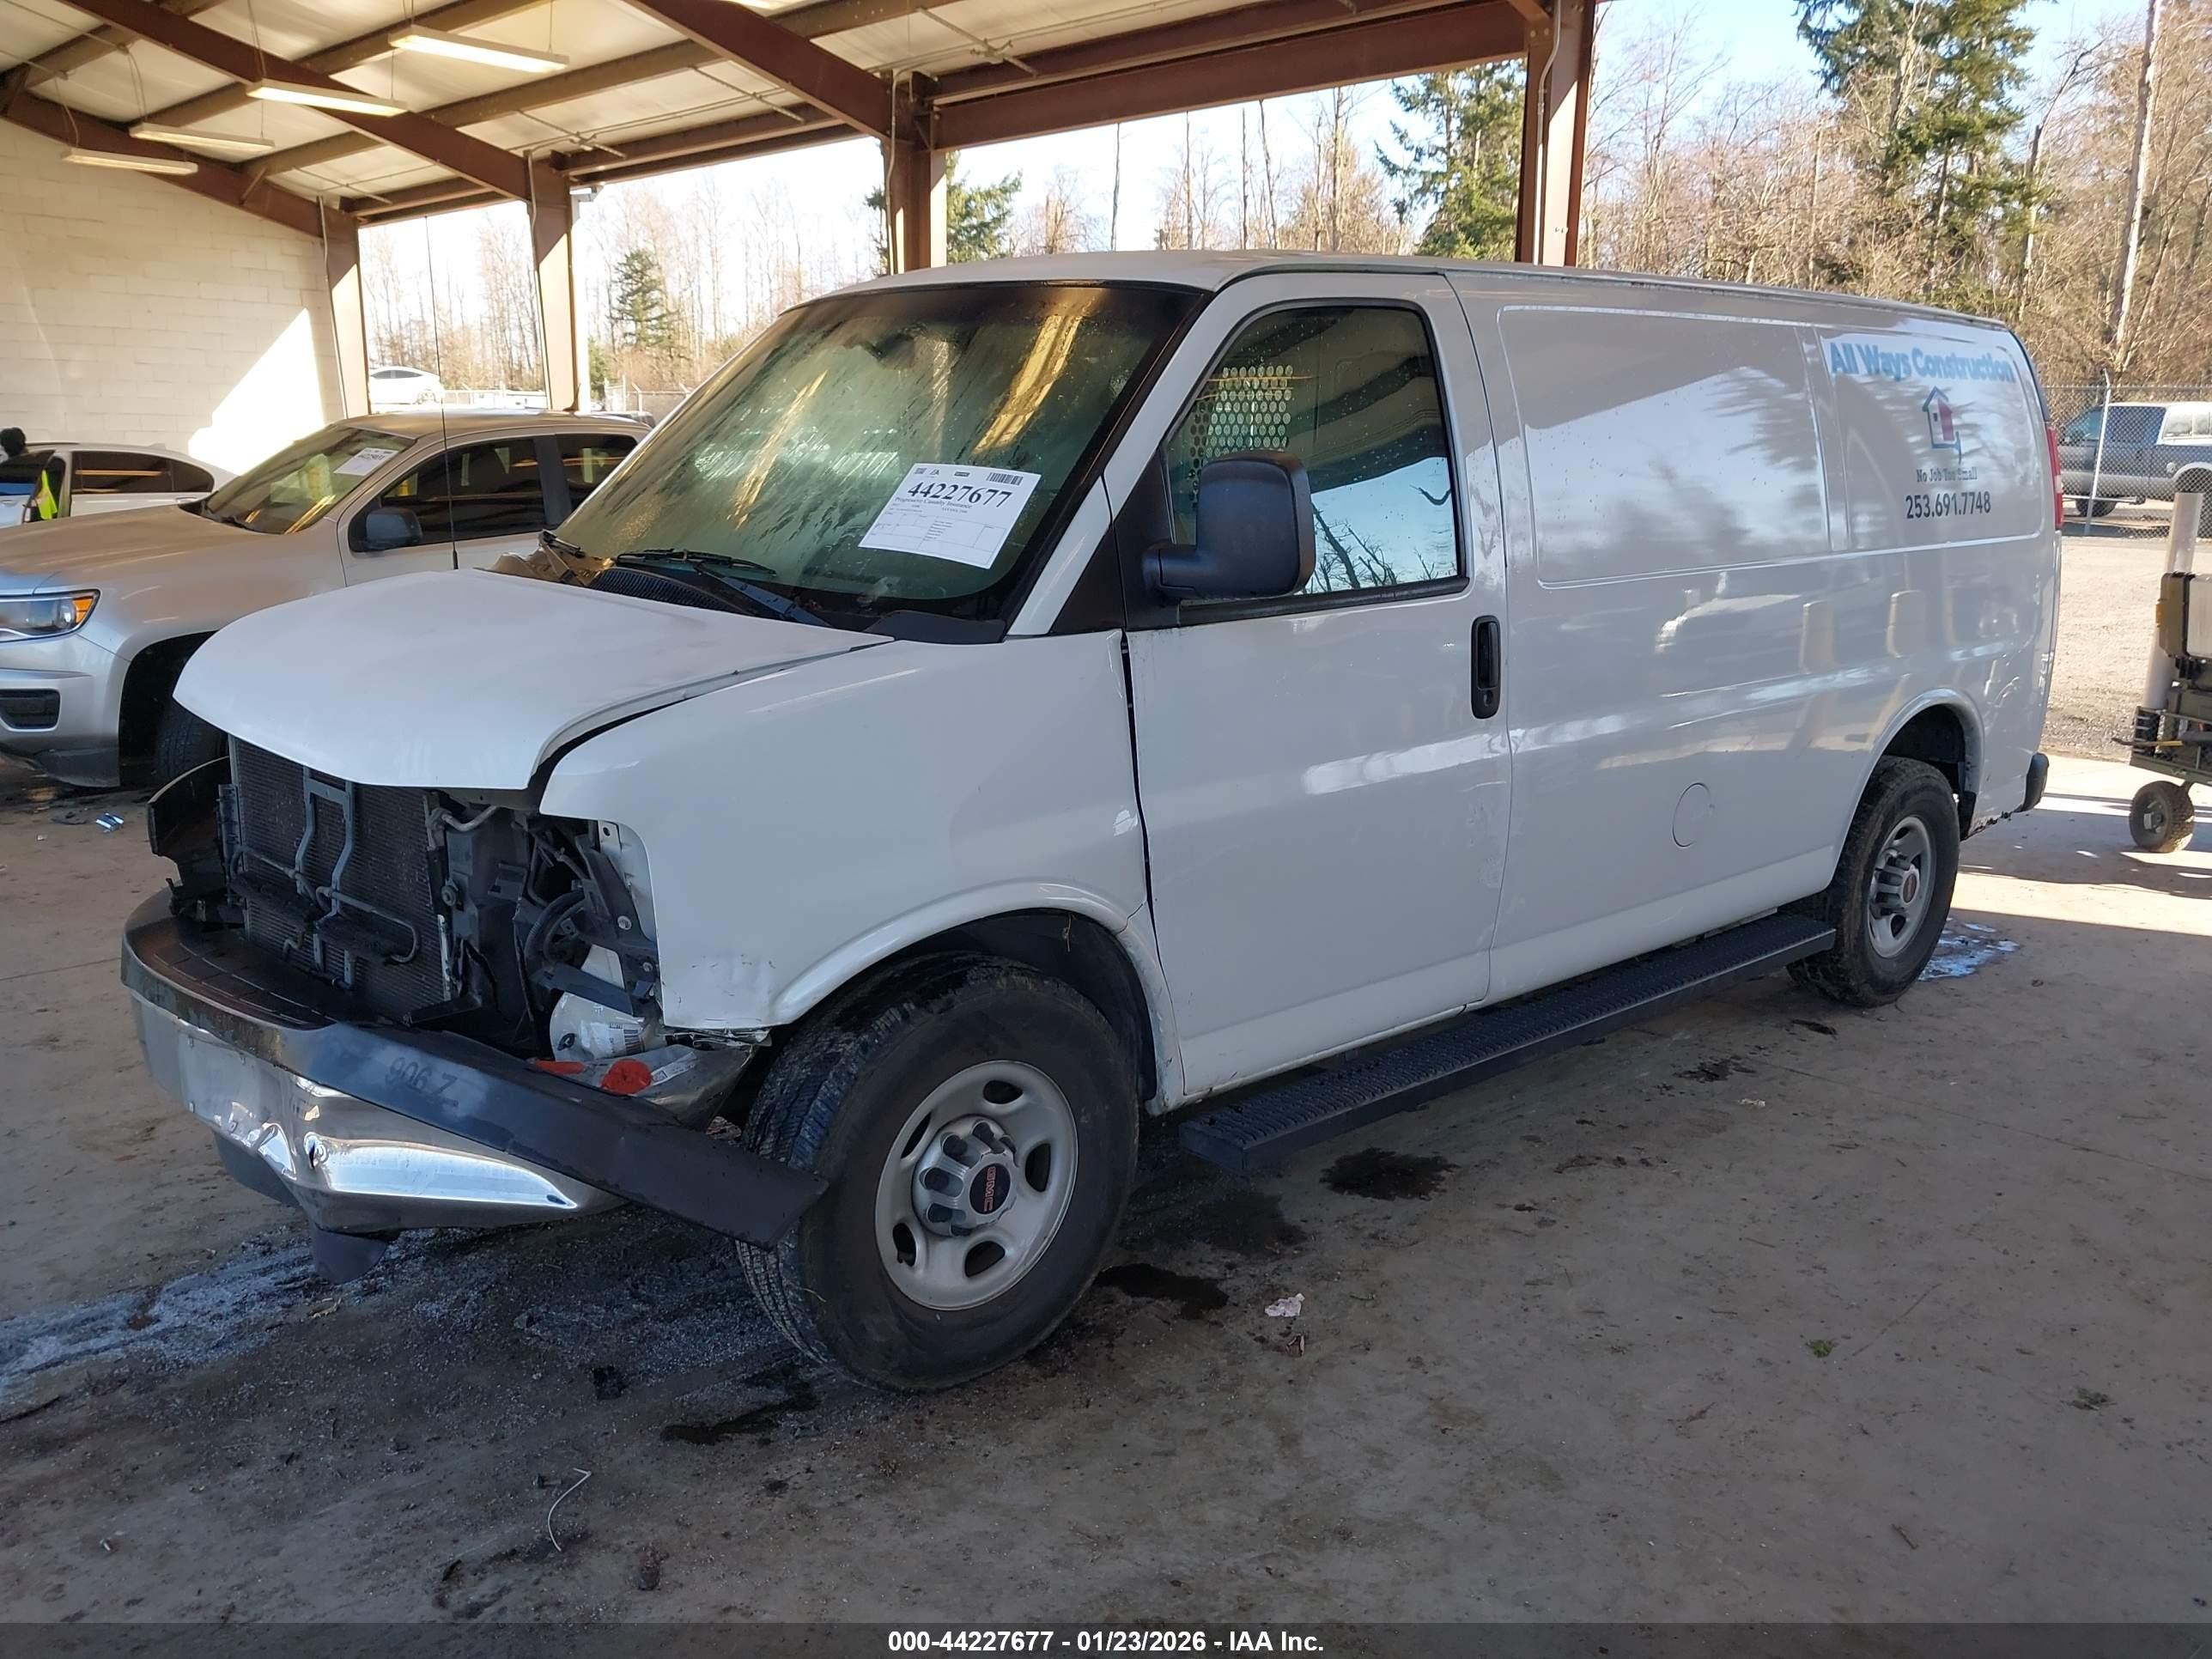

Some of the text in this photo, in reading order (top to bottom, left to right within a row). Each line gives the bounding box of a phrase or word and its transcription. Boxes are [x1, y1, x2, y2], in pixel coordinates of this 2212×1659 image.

[1830, 342, 2016, 383] All Ways Construction
[1916, 468, 1928, 483] No
[1929, 467, 1942, 482] Job
[908, 482, 1012, 507] 44227677
[1905, 490, 1991, 520] 253.691.7748
[983, 1166, 997, 1212] GMC
